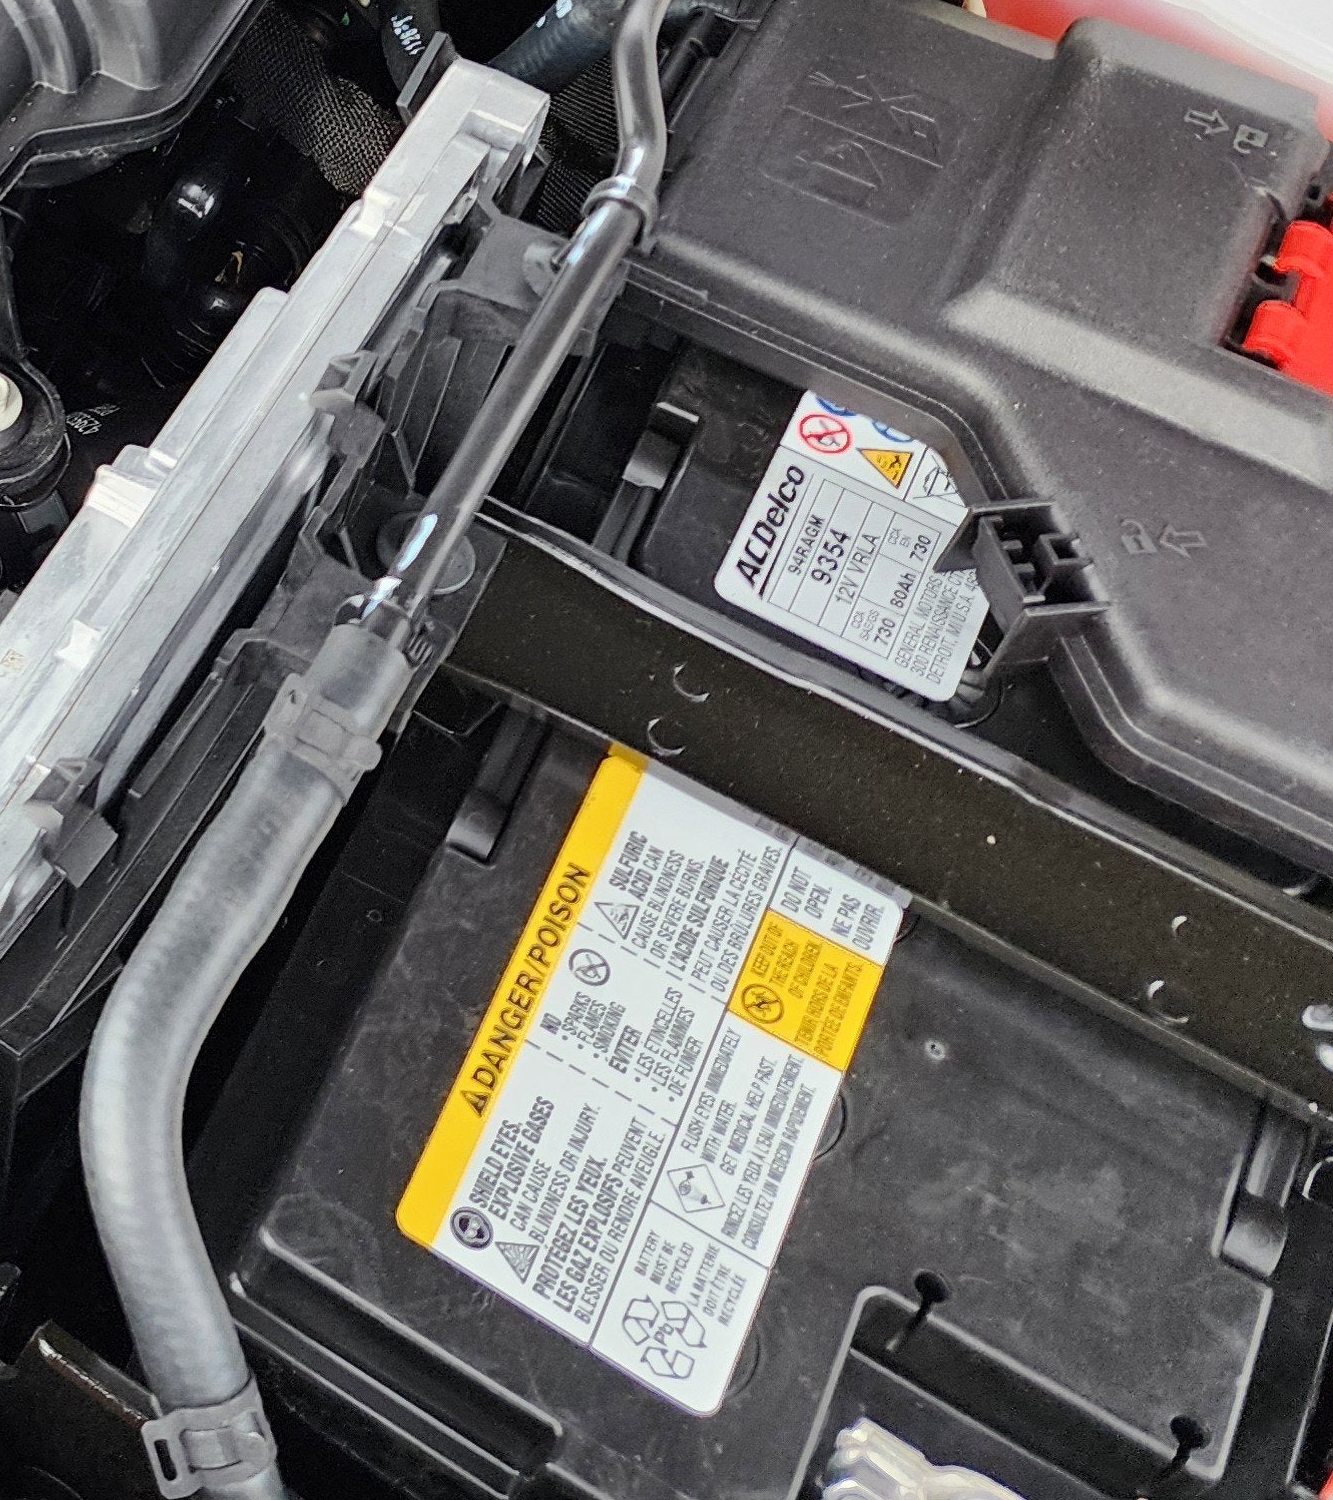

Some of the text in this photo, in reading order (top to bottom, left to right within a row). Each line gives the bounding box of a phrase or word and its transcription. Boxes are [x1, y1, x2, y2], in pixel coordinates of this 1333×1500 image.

[735, 464, 805, 588] ACDelco
[908, 534, 932, 562] 730
[810, 528, 851, 585] 9354
[834, 533, 881, 605] 12V VRLA
[889, 572, 917, 609] 80Ah
[872, 617, 896, 646] 730
[893, 574, 944, 669] GENERAL MOTORS
[914, 583, 959, 656] RENAISSANCE
[909, 653, 930, 677] 300
[608, 830, 648, 891] SULFURIC
[627, 844, 665, 902] ACID CAN
[630, 849, 685, 950] CAUSE BLINDNESS
[685, 854, 730, 929] SULFURIQUE
[779, 865, 811, 913] DO NOT
[829, 893, 862, 938] NE PAS
[656, 895, 688, 942] SEVERE
[689, 948, 715, 983] PEUT
[703, 904, 734, 952] CAUSER
[721, 889, 742, 908] LA
[470, 861, 591, 1092] DANGER/POISON
[649, 939, 669, 960] OR
[715, 948, 739, 975] DES
[709, 973, 730, 993] OU
[560, 990, 592, 1036] SPARKS
[575, 999, 608, 1045] FLAMES
[591, 1000, 627, 1054] SMOKING
[633, 1051, 656, 1078] LES
[650, 1005, 696, 1087] LES FLAMMES
[666, 1035, 703, 1097] DE FUMER
[679, 1116, 705, 1153] FLUSH
[693, 1090, 716, 1120] EYES
[699, 1133, 721, 1164] WITH
[718, 1150, 738, 1176] GET
[744, 1080, 766, 1111] HELP
[468, 1119, 523, 1209] SHIELD EYES.
[487, 1095, 555, 1221] EXPLOSIVE GASES
[574, 1154, 608, 1196] YEUX.
[508, 1158, 552, 1232] CAN CAUSE
[527, 1169, 571, 1245] BLINDNESS
[558, 1149, 579, 1173] OR
[552, 1115, 647, 1313] LES GAZ EXPLOSIFS PEUVENT
[563, 1194, 590, 1226] LES
[606, 1186, 642, 1243] RENDRE
[734, 1183, 754, 1206] LES
[598, 1240, 619, 1265] OU
[633, 1229, 660, 1277] BATTERY
[648, 1239, 676, 1285] MUST BE
[664, 1241, 694, 1295] RECYCLED
[573, 1261, 611, 1325] BLESSER
[687, 1291, 701, 1308] LA
[652, 1322, 675, 1347] Pb
